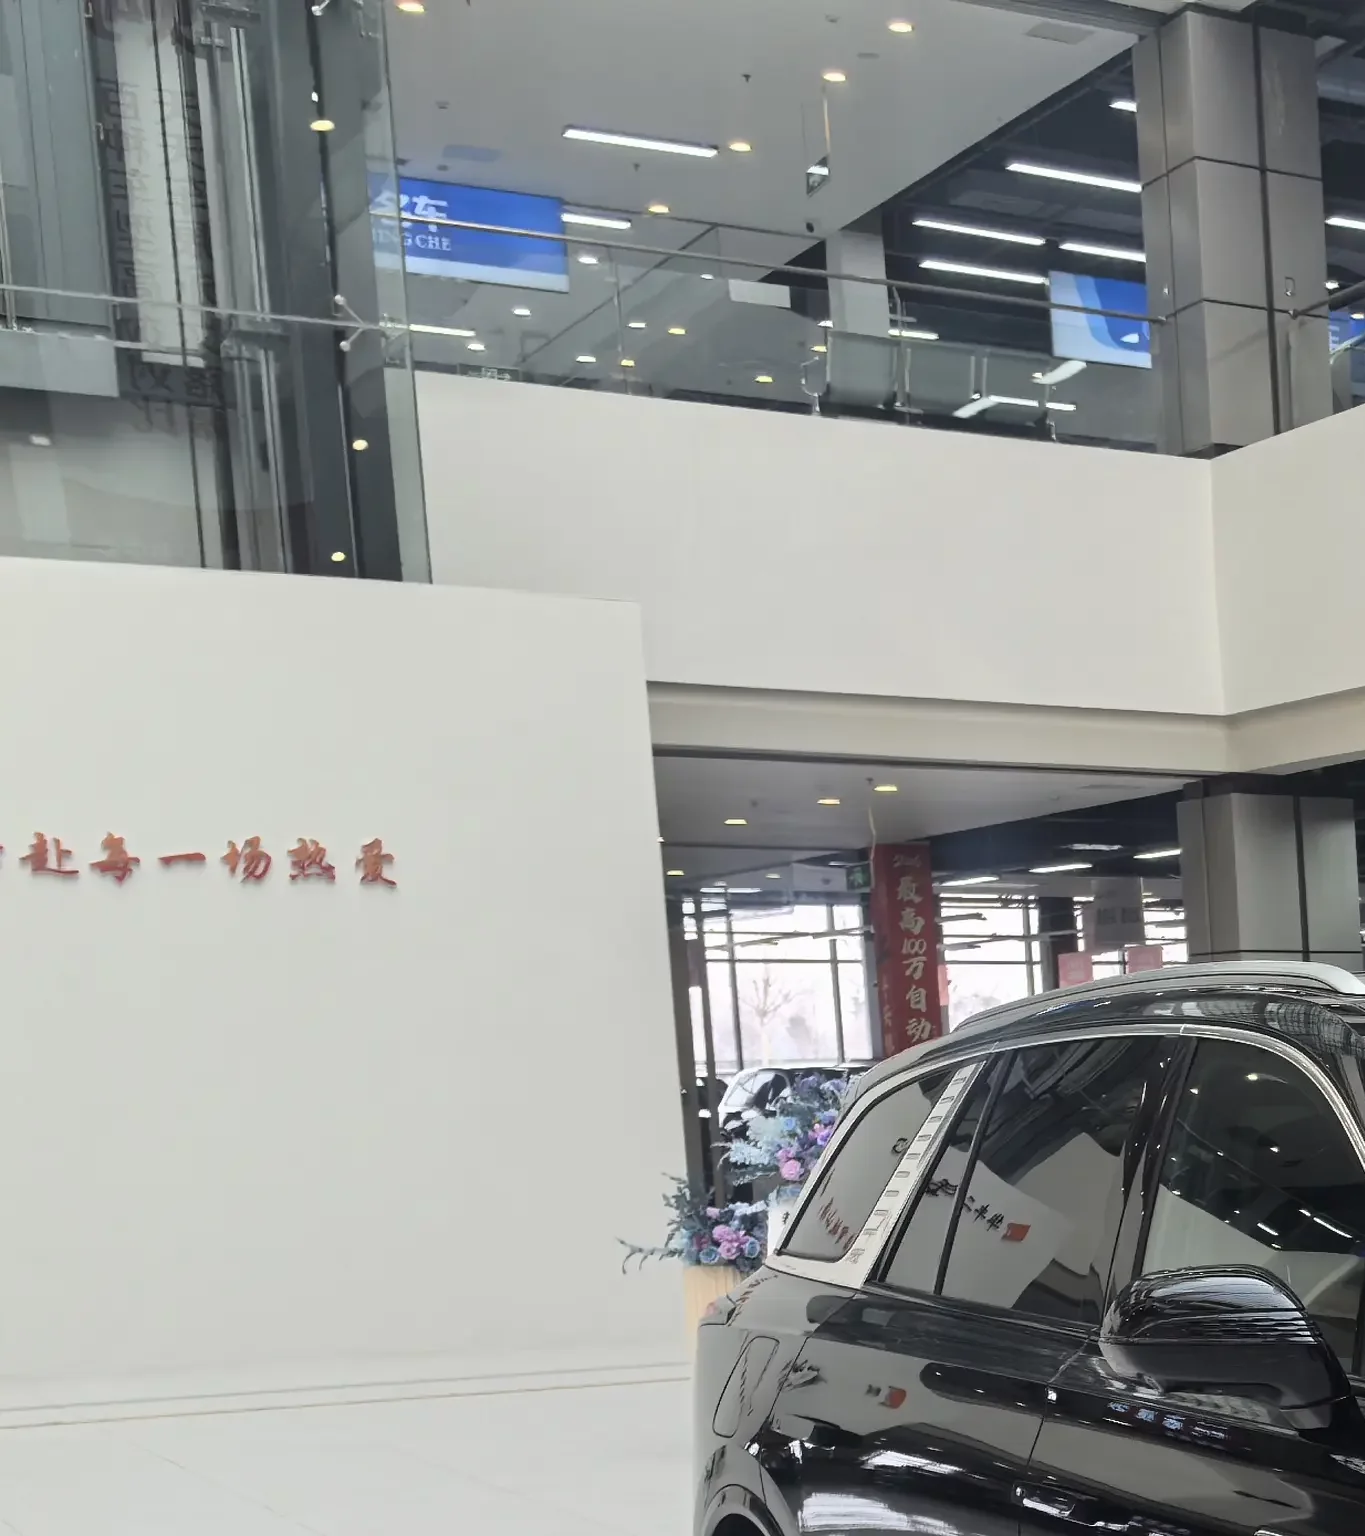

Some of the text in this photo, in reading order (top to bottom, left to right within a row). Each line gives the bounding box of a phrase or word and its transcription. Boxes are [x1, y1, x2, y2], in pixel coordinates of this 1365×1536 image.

[0, 831, 397, 888] 赴每一场热爱
